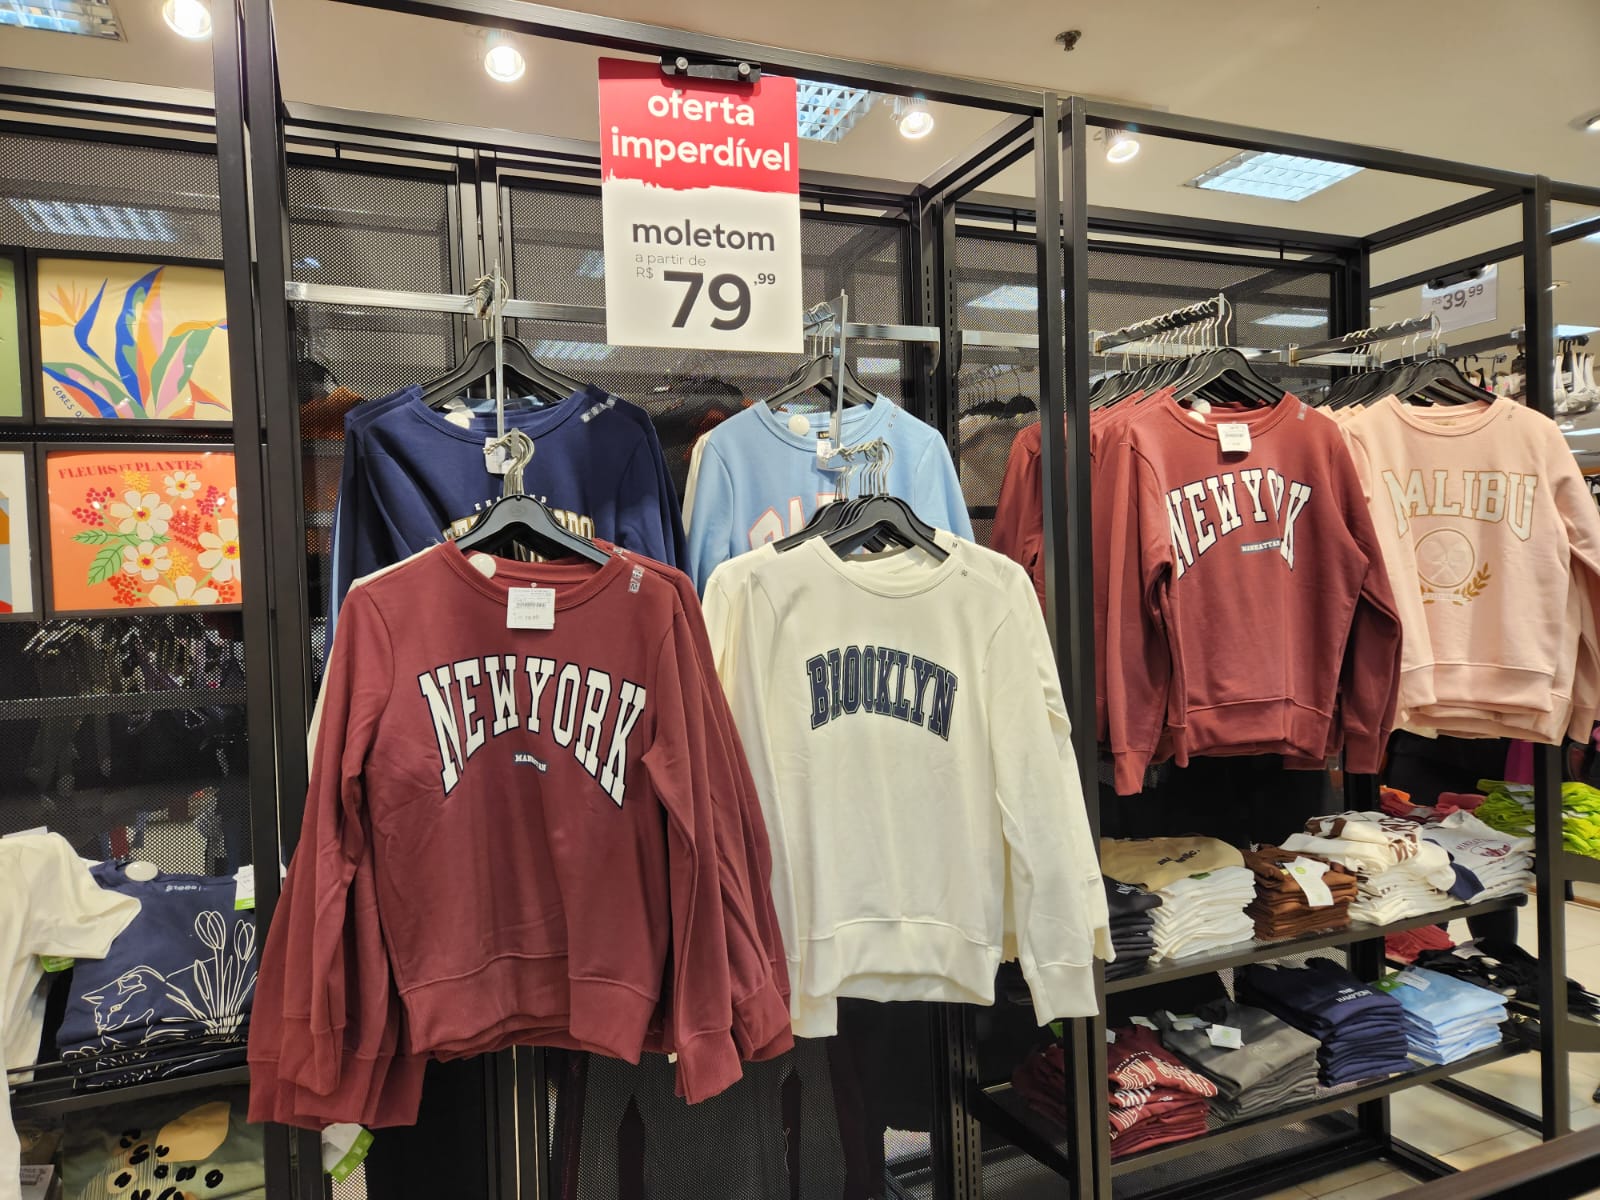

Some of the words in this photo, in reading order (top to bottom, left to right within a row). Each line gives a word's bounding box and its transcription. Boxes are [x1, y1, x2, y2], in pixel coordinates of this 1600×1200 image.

[647, 89, 755, 127] oferta
[610, 126, 791, 172] imperdível
[631, 219, 776, 252] moletom
[635, 254, 644, 263] a
[647, 252, 685, 268] partir
[688, 254, 707, 267] de
[635, 265, 654, 279] R$
[52, 385, 75, 410] CORES
[58, 464, 118, 479] FLEURS
[135, 460, 203, 473] PLANTES
[1165, 472, 1243, 580] NEW
[806, 645, 958, 742] BROOKLYN
[417, 654, 520, 797] NEW
[525, 655, 647, 809] YORK
